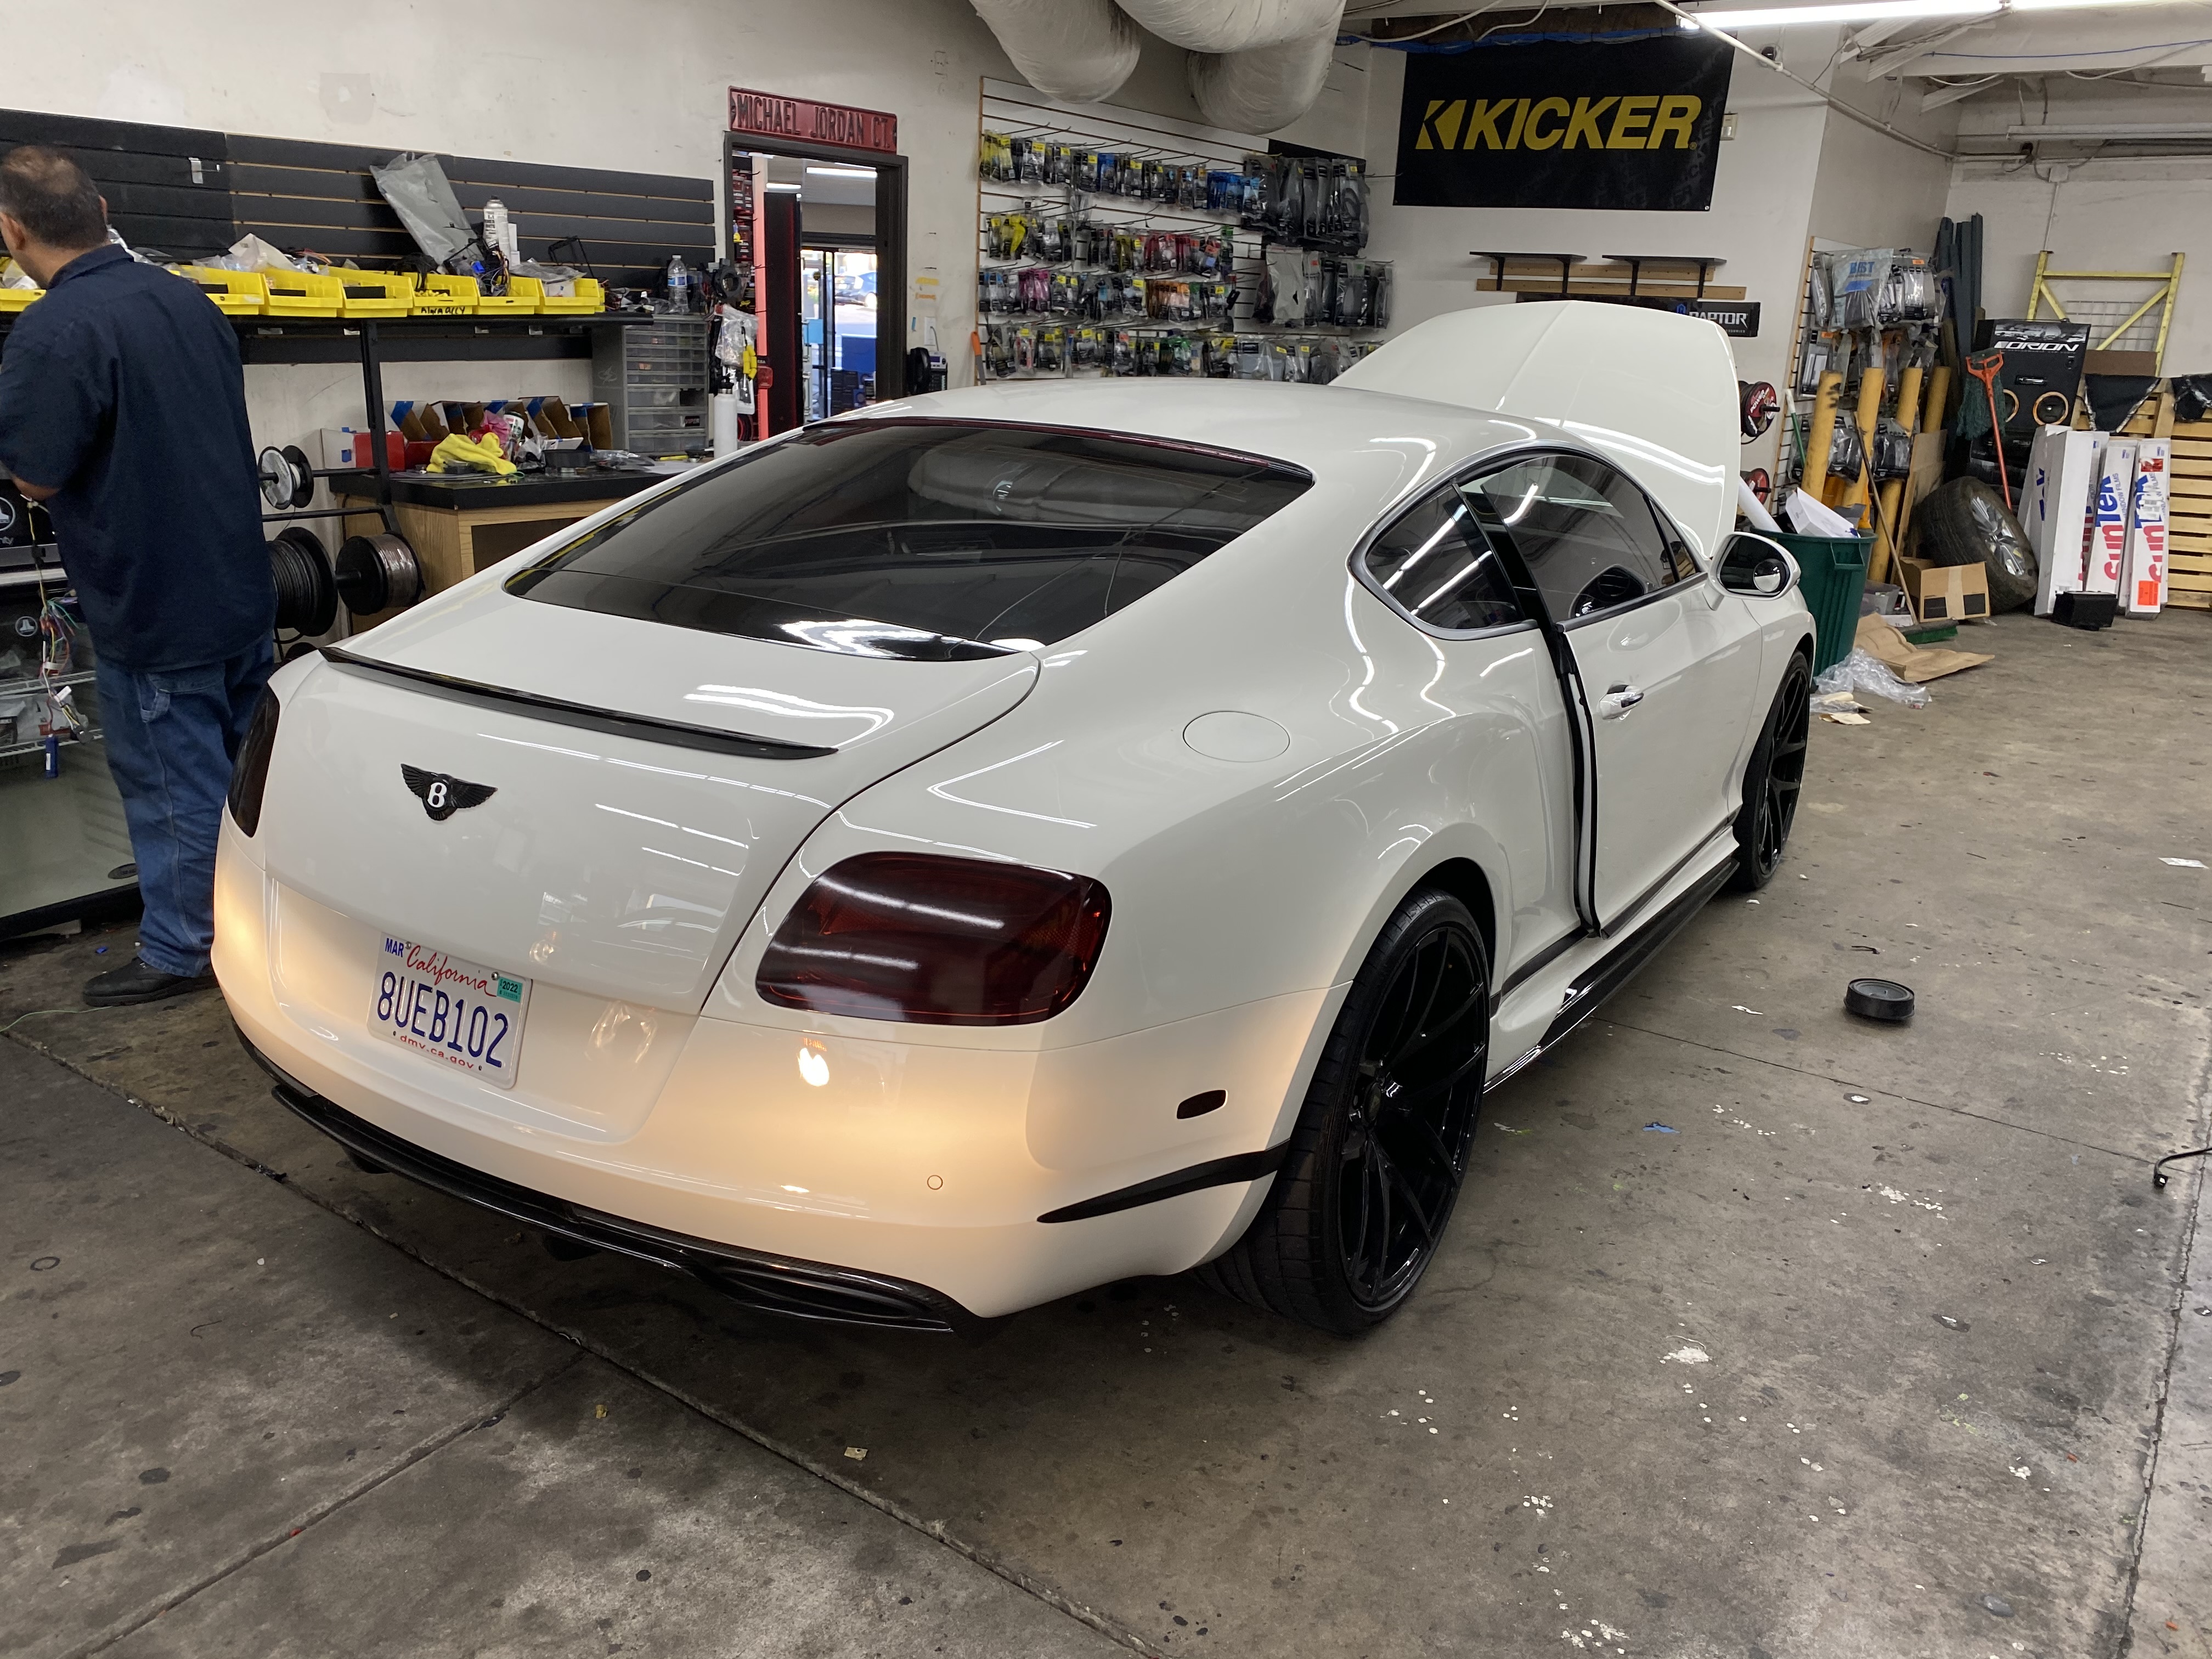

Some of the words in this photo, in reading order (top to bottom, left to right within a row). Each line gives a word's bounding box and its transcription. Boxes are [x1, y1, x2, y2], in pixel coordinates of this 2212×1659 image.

[736, 93, 801, 136] MICHAEL
[810, 105, 865, 145] JORDAN
[1463, 95, 1702, 150] KICKER
[2005, 341, 2079, 352] ORION
[2112, 473, 2122, 490] FILMS
[427, 782, 447, 808] B
[385, 938, 404, 957] MAR
[407, 945, 497, 997] California
[502, 980, 518, 993] 2022
[377, 972, 508, 1068] 8UEB102
[400, 1035, 475, 1069] dmv.ca.gov
